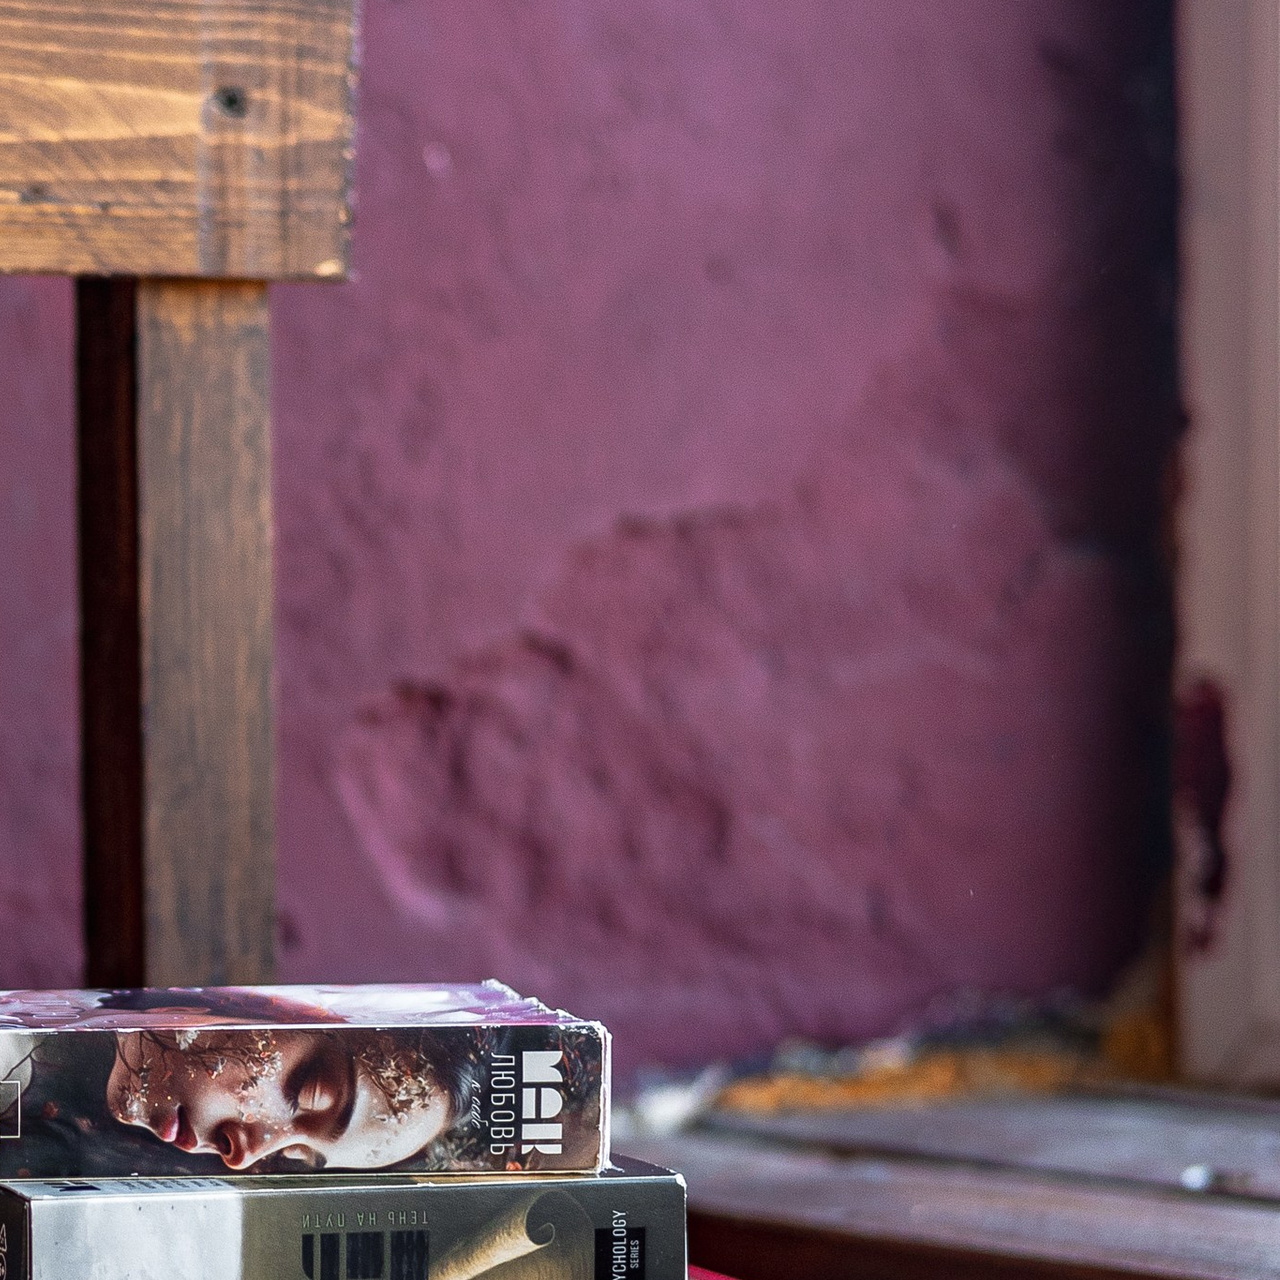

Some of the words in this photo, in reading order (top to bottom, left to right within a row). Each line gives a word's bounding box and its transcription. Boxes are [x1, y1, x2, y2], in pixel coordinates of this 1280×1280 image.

[490, 1053, 516, 1156] ЛЮБОВЬ
[301, 1213, 345, 1228] ПУТИ
[357, 1212, 377, 1226] НА
[387, 1210, 429, 1225] ТЕНЬ
[630, 1239, 640, 1269] SERIES
